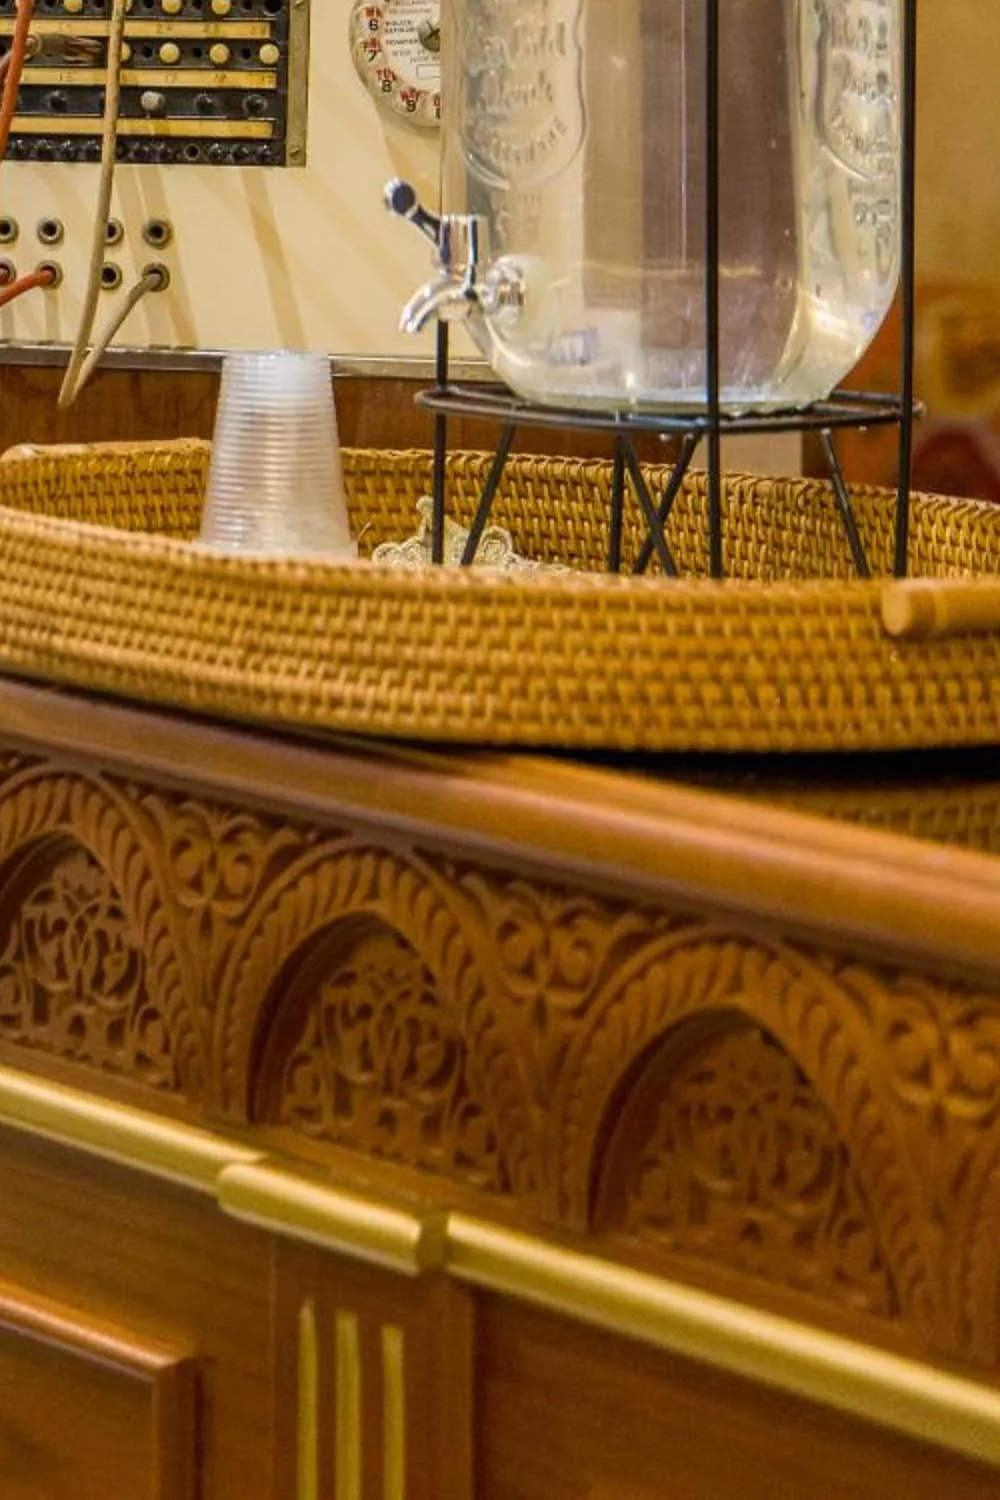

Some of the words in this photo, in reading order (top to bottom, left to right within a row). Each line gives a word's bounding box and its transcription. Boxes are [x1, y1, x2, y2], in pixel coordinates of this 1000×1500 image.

[368, 18, 379, 31] 6
[368, 50, 378, 63] 7
[381, 79, 393, 93] 8
[405, 100, 417, 113] 9
